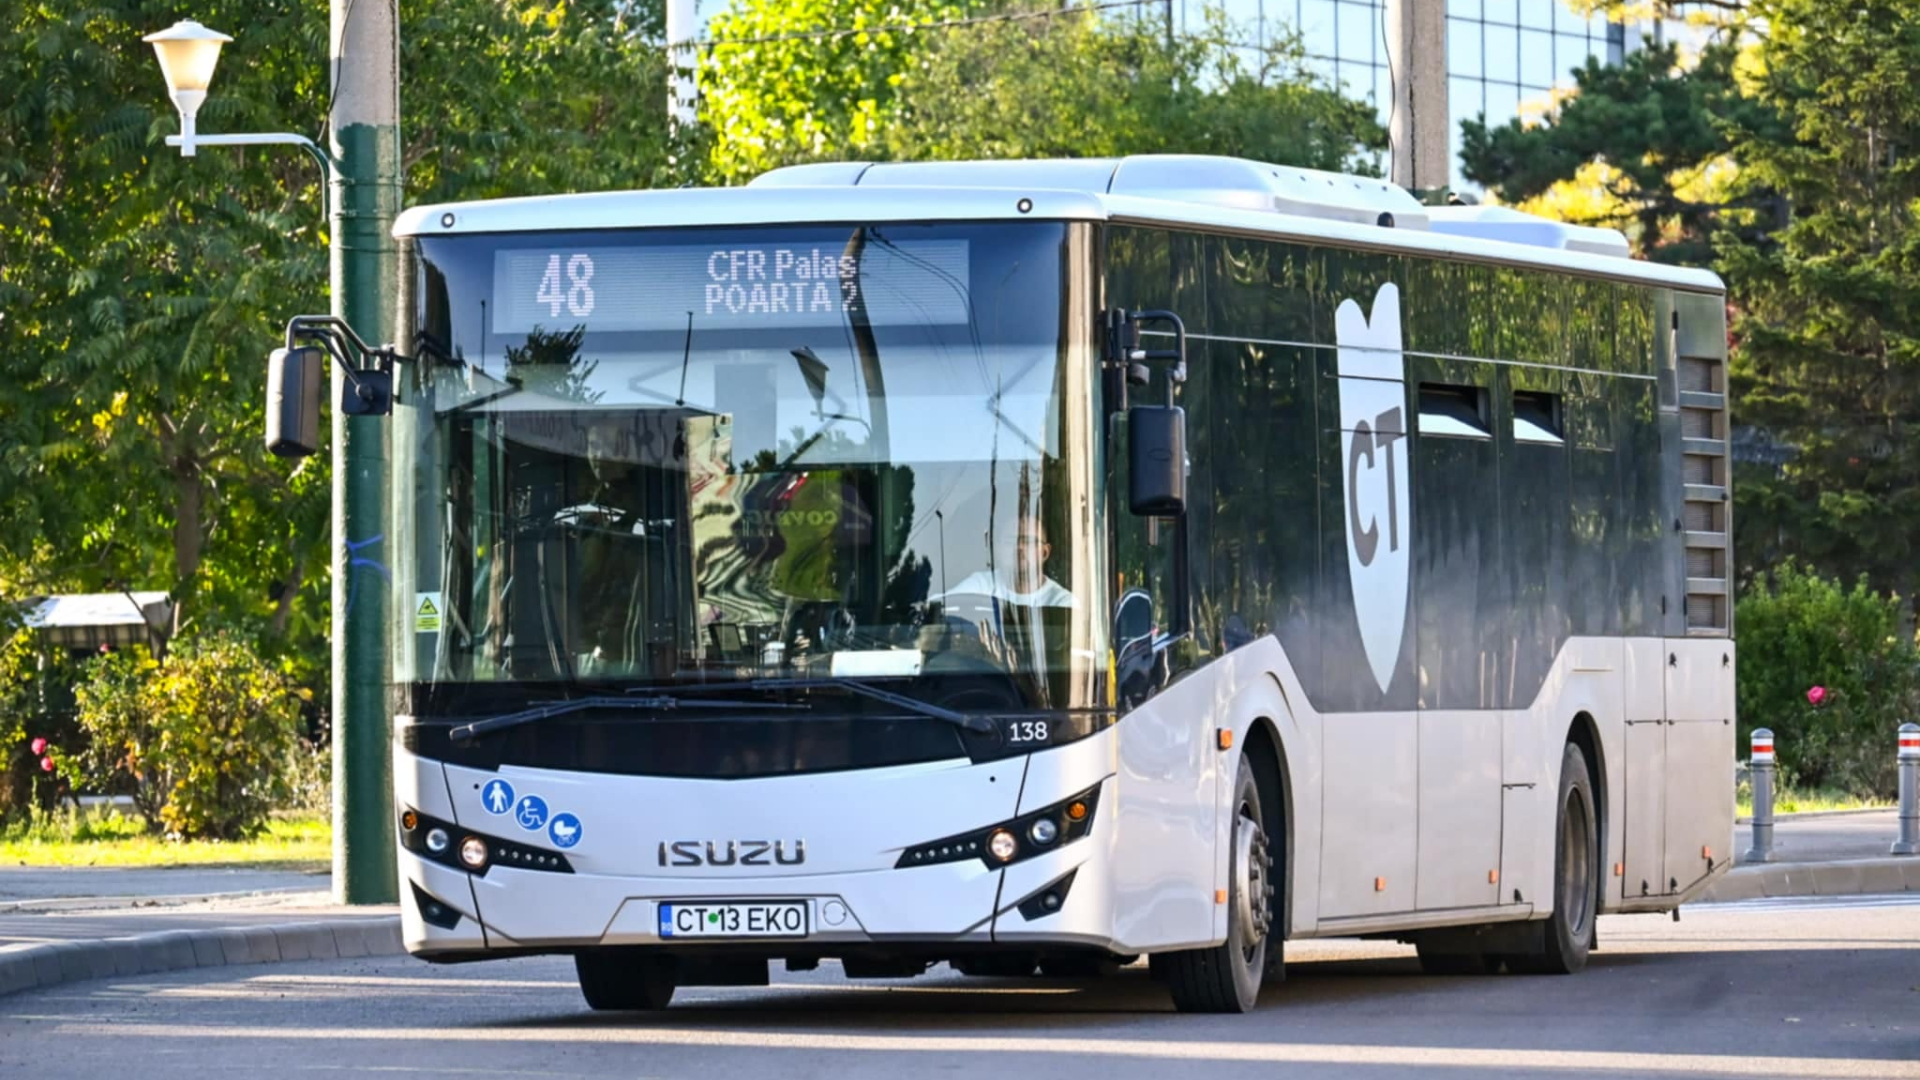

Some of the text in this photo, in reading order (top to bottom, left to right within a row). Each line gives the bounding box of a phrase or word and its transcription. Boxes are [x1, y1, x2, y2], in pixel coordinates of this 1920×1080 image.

[707, 248, 857, 281] CFR Palas
[536, 254, 595, 317] 48
[705, 281, 858, 314] POARTA 2
[1349, 405, 1402, 568] CT
[1010, 721, 1049, 742] 138
[657, 839, 806, 868] ISUZU
[676, 907, 802, 932] CT 13 EKO
